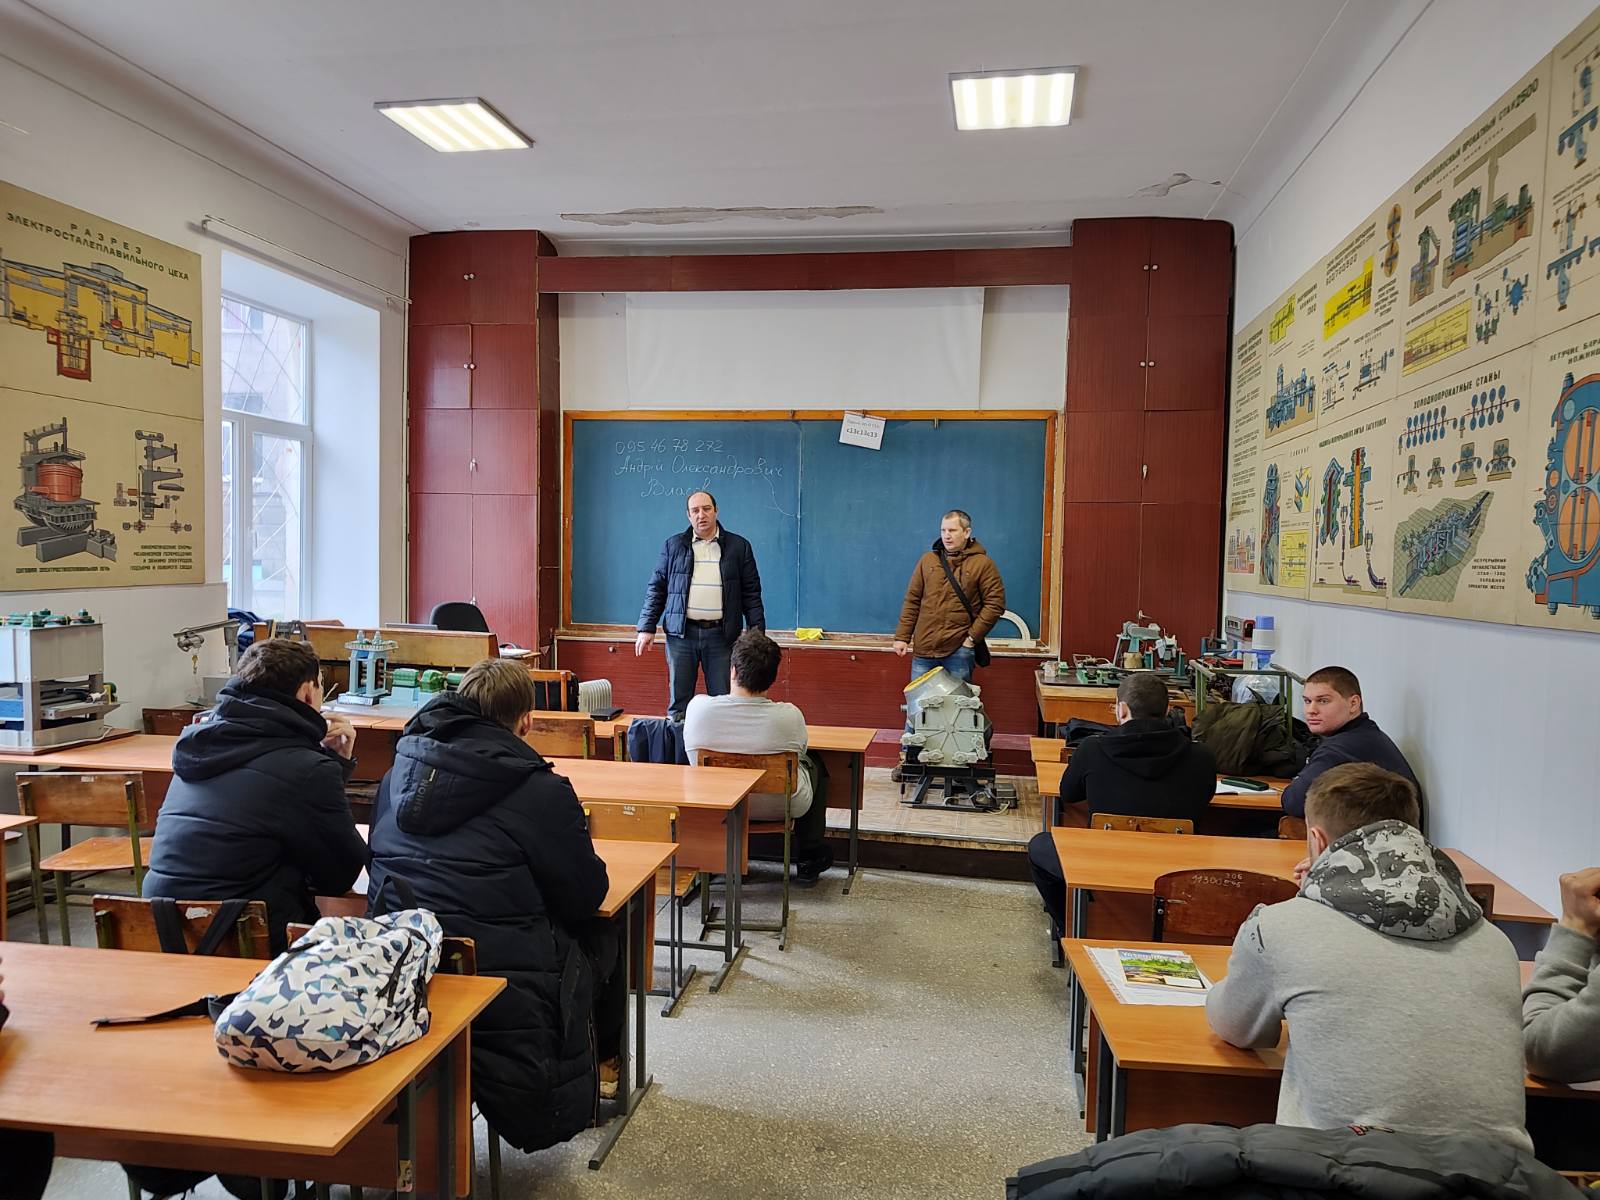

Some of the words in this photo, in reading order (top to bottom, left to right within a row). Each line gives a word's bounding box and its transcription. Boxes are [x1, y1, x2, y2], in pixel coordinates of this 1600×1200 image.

[7, 213, 164, 272] ЭЛЕКТРОСТАЛЕПЛАВИЛЬНОГО
[168, 267, 189, 281] ЦЕХА
[70, 223, 142, 255] РАЗРЕЗ
[1413, 380, 1472, 409] ХОЛОДНОПРОКАТНЫЕ
[1475, 370, 1501, 388] СТАНЫ
[615, 441, 646, 454] 095
[650, 438, 667, 453] 46
[672, 438, 690, 452] 78
[695, 440, 724, 452] 272
[671, 454, 784, 479] Олександрович
